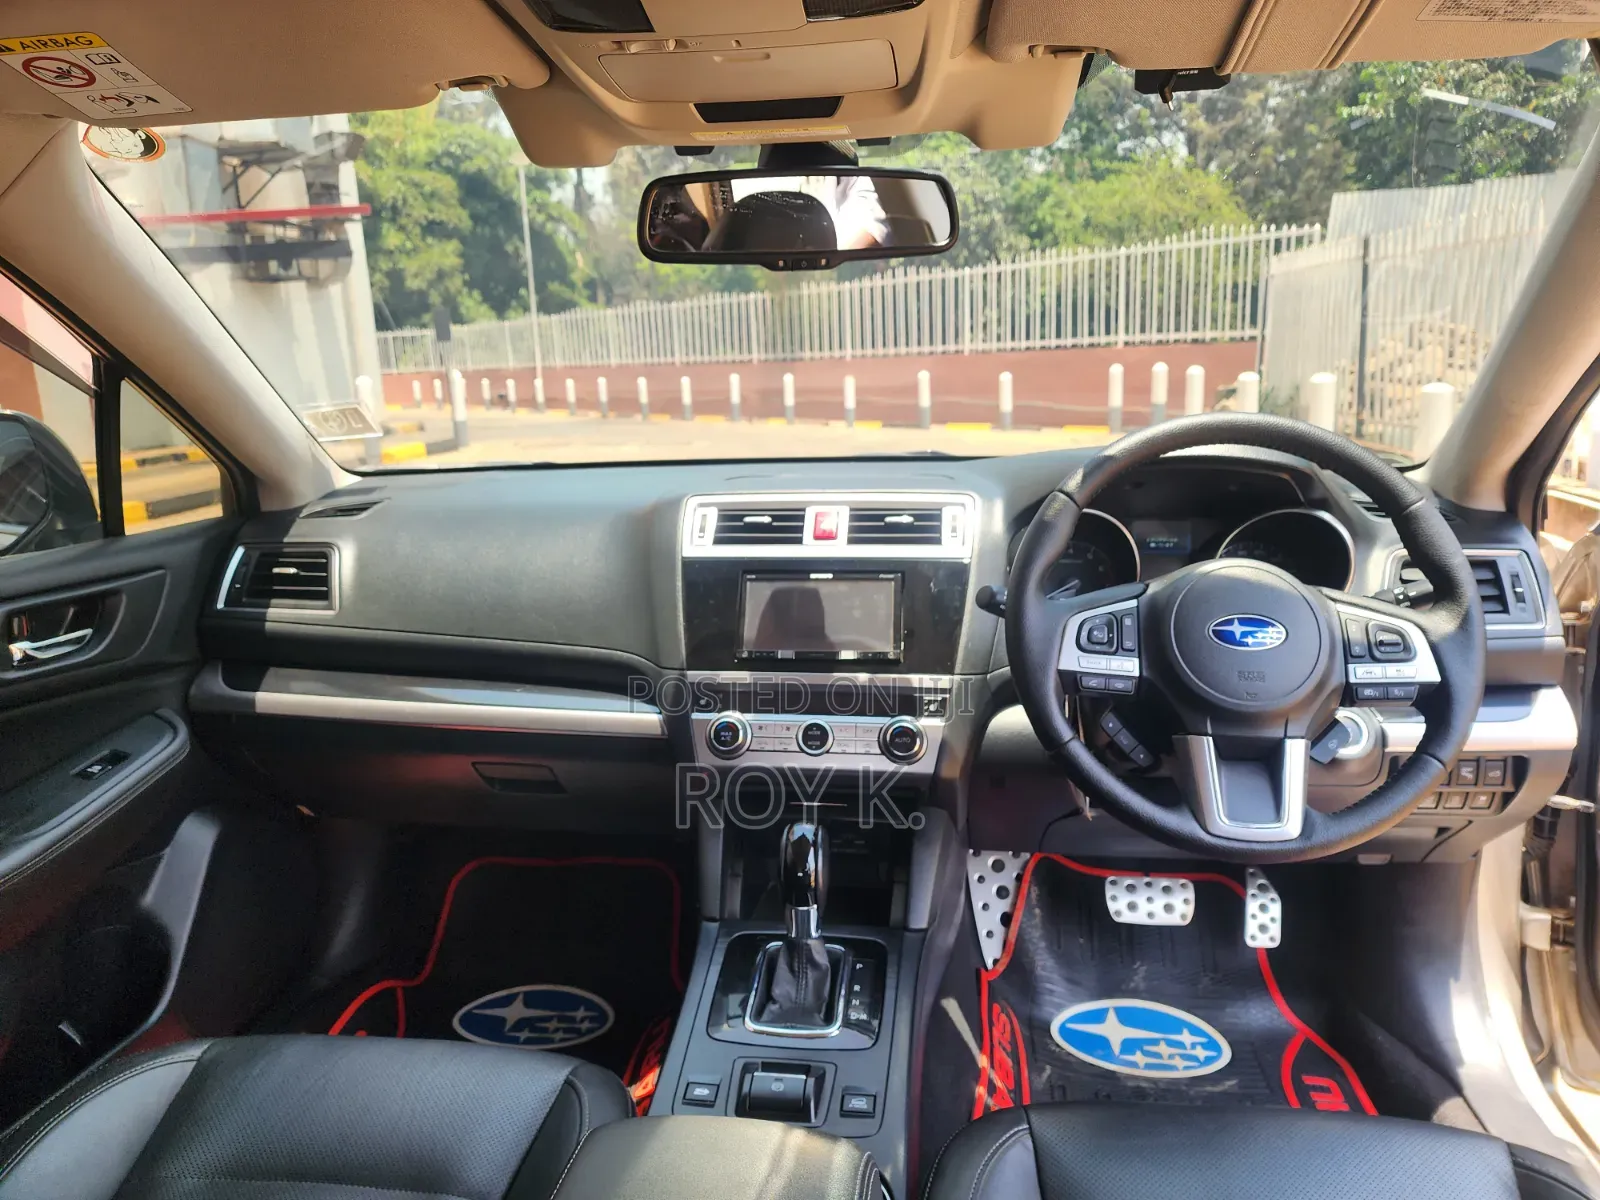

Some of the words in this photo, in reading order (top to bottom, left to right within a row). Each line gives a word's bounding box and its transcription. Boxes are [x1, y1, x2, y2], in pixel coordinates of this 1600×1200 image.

[19, 35, 94, 51] AIRBAG
[853, 984, 861, 992] R
[851, 998, 860, 1006] N
